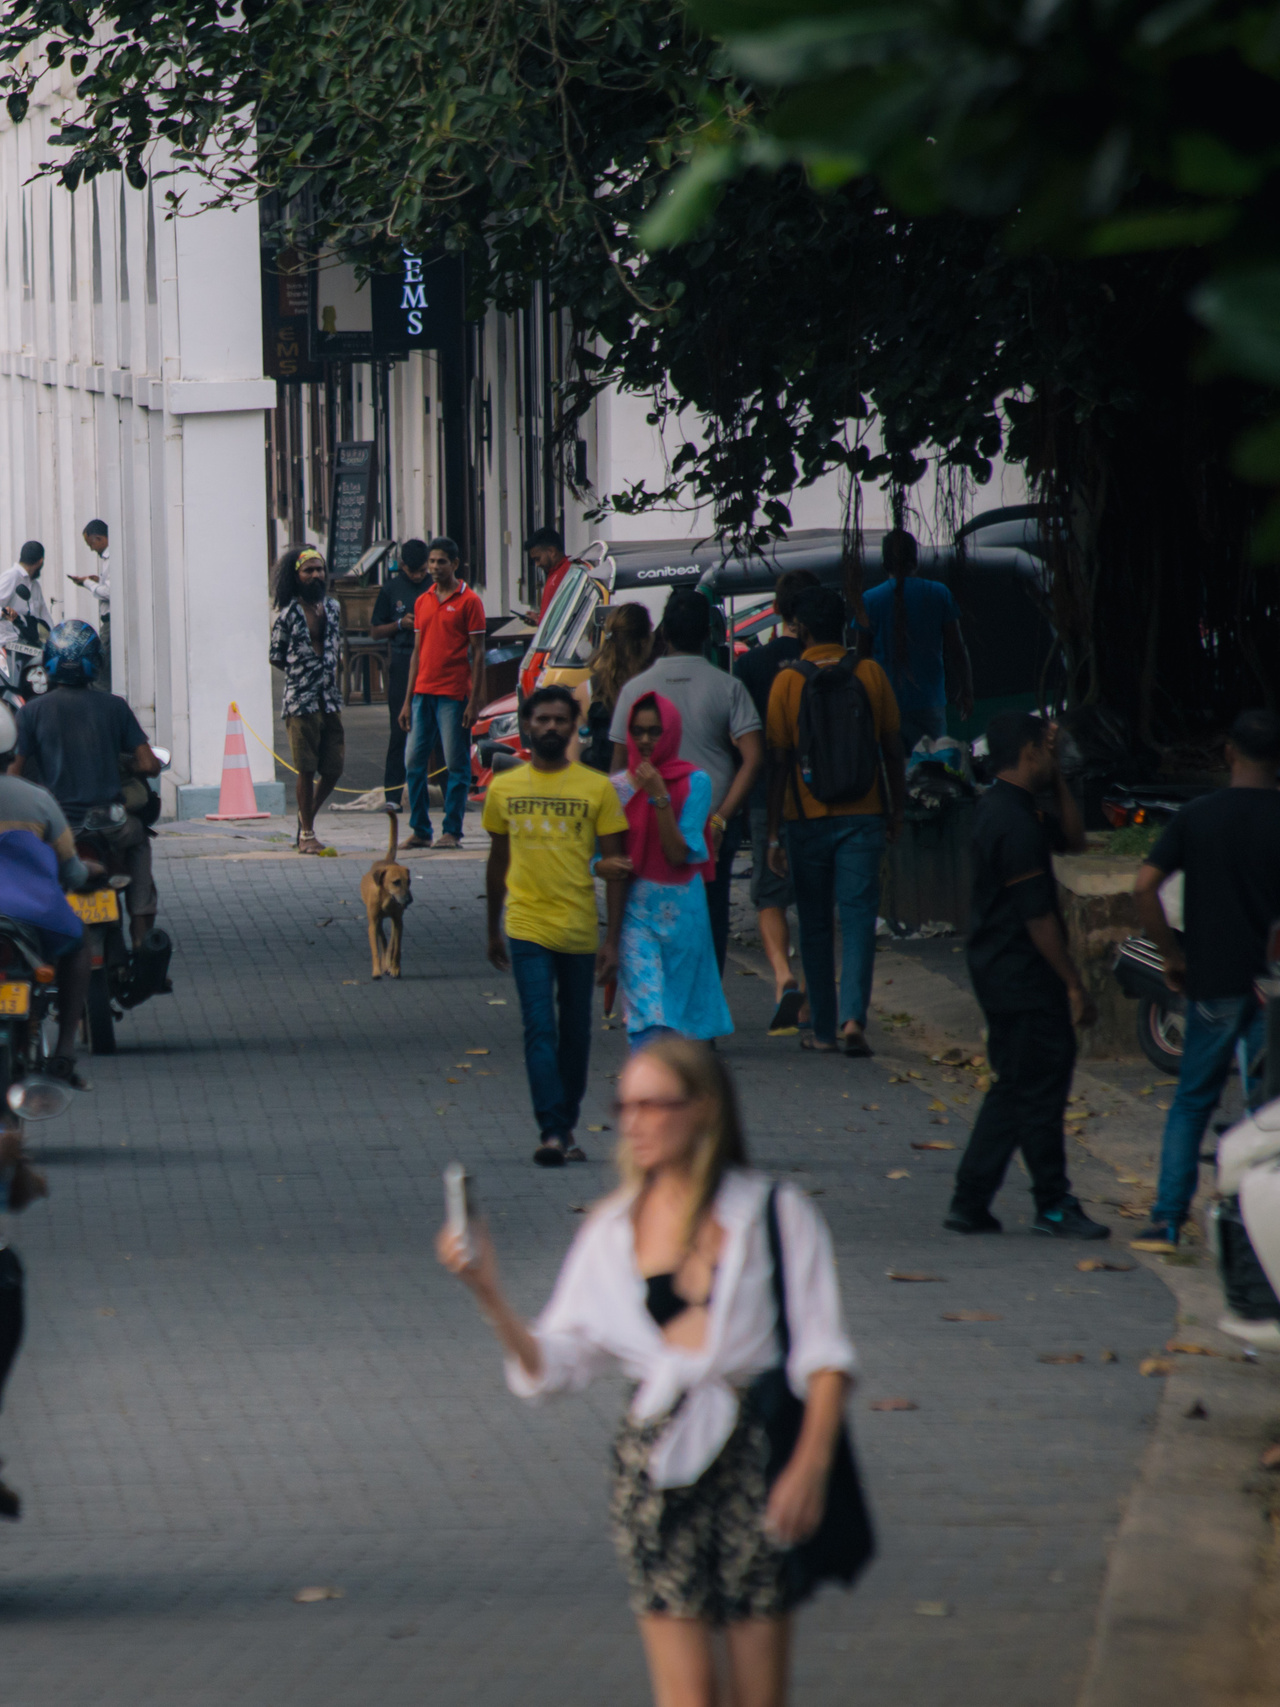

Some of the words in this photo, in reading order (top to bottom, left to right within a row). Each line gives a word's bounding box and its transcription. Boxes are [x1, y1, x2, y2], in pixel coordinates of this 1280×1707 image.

[400, 242, 429, 335] EMS
[636, 563, 701, 580] canibeat
[506, 796, 590, 818] Ferrari
